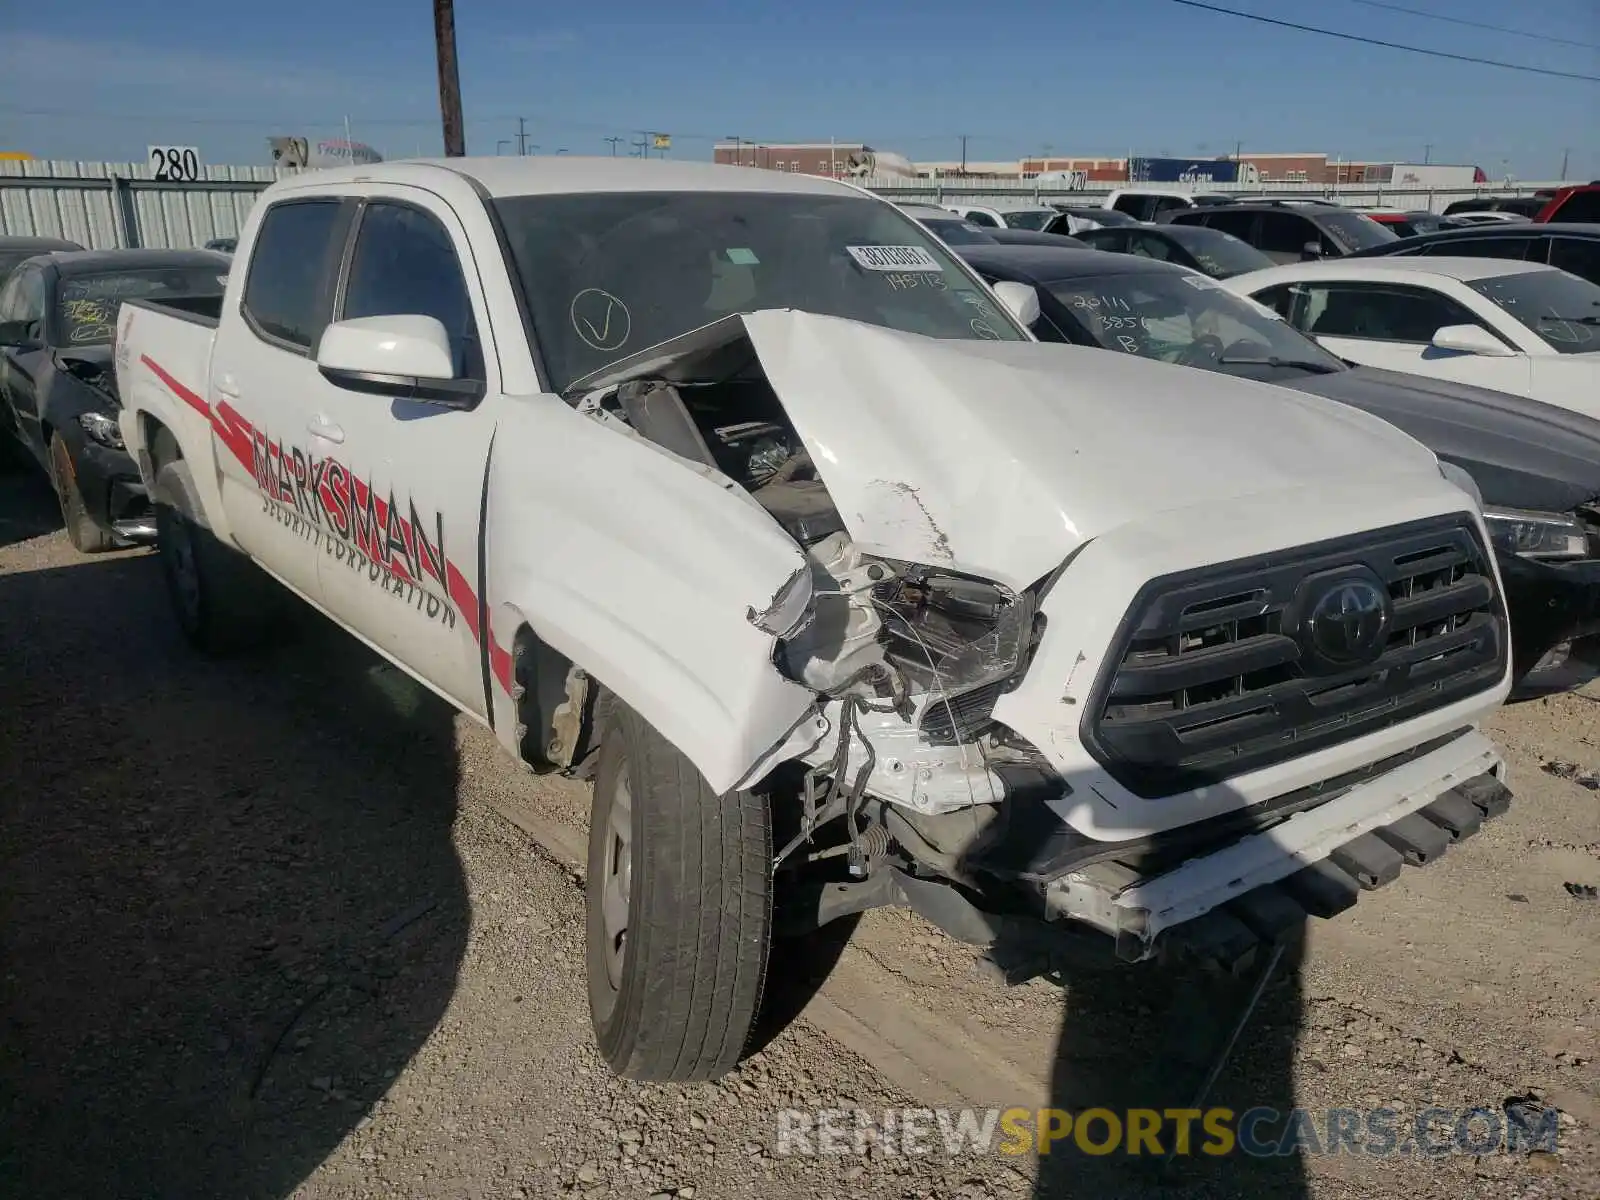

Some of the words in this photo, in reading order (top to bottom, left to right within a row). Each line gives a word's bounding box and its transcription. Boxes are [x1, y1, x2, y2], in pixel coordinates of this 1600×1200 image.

[152, 148, 198, 181] 280
[1069, 171, 1086, 191] 270
[253, 430, 449, 598] MARKSMAN
[262, 495, 321, 545] SECURITY
[326, 532, 456, 629] CORPORATION
